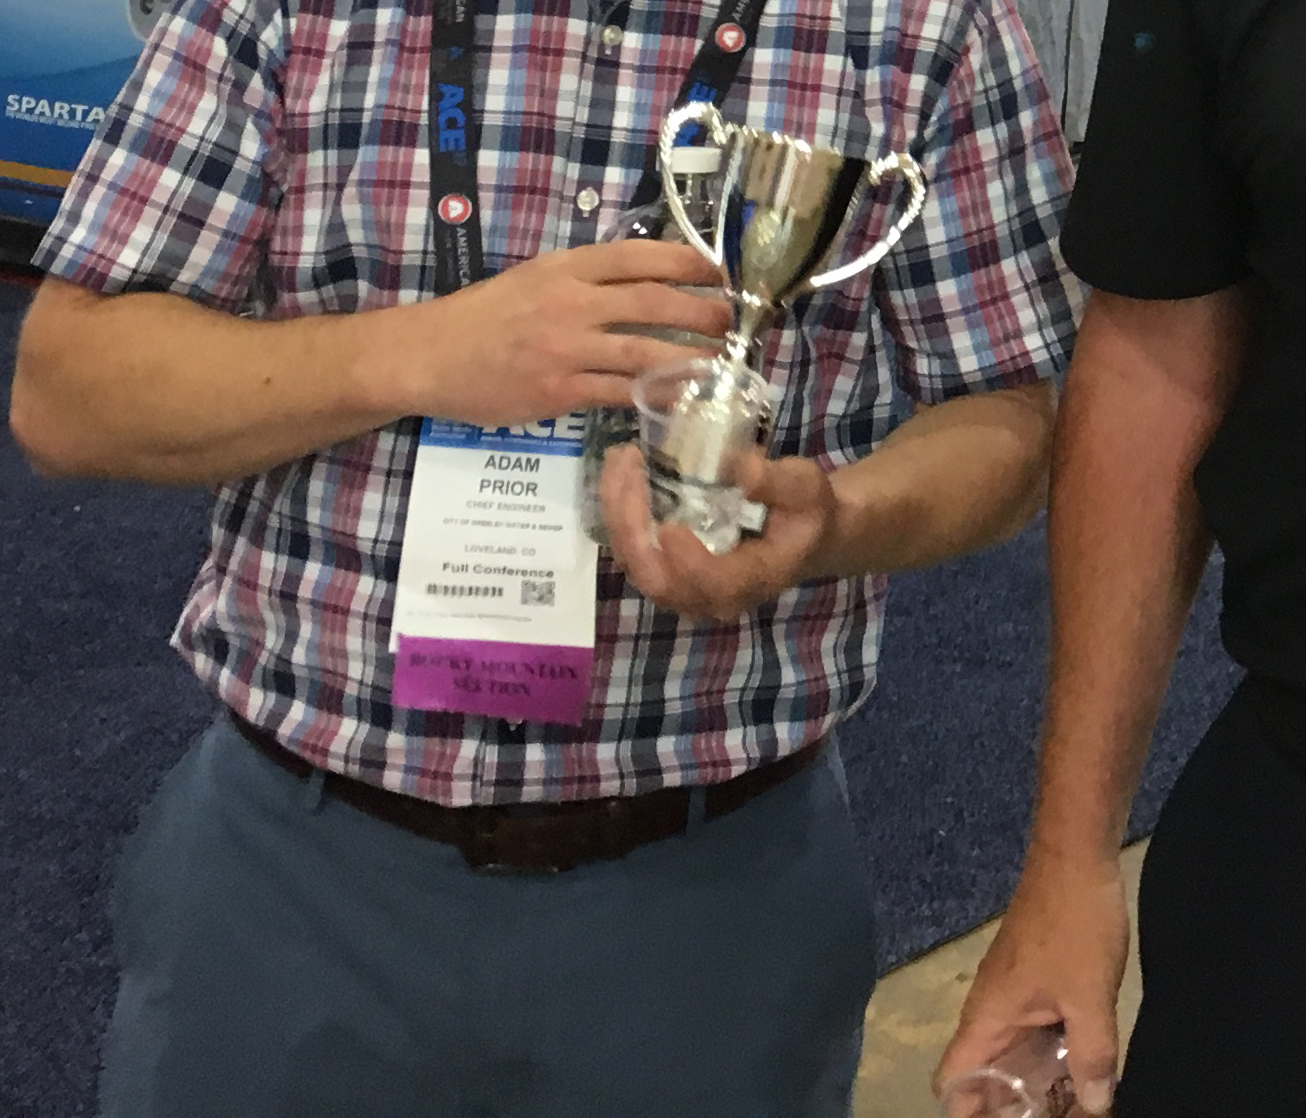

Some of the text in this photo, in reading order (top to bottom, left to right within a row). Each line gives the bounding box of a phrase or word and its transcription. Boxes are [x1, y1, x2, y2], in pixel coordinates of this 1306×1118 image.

[5, 94, 106, 123] SPARTA
[438, 82, 467, 153] ACE
[484, 454, 541, 474] ADAM
[478, 478, 539, 498] PRIOR
[441, 561, 556, 579] Full Conference
